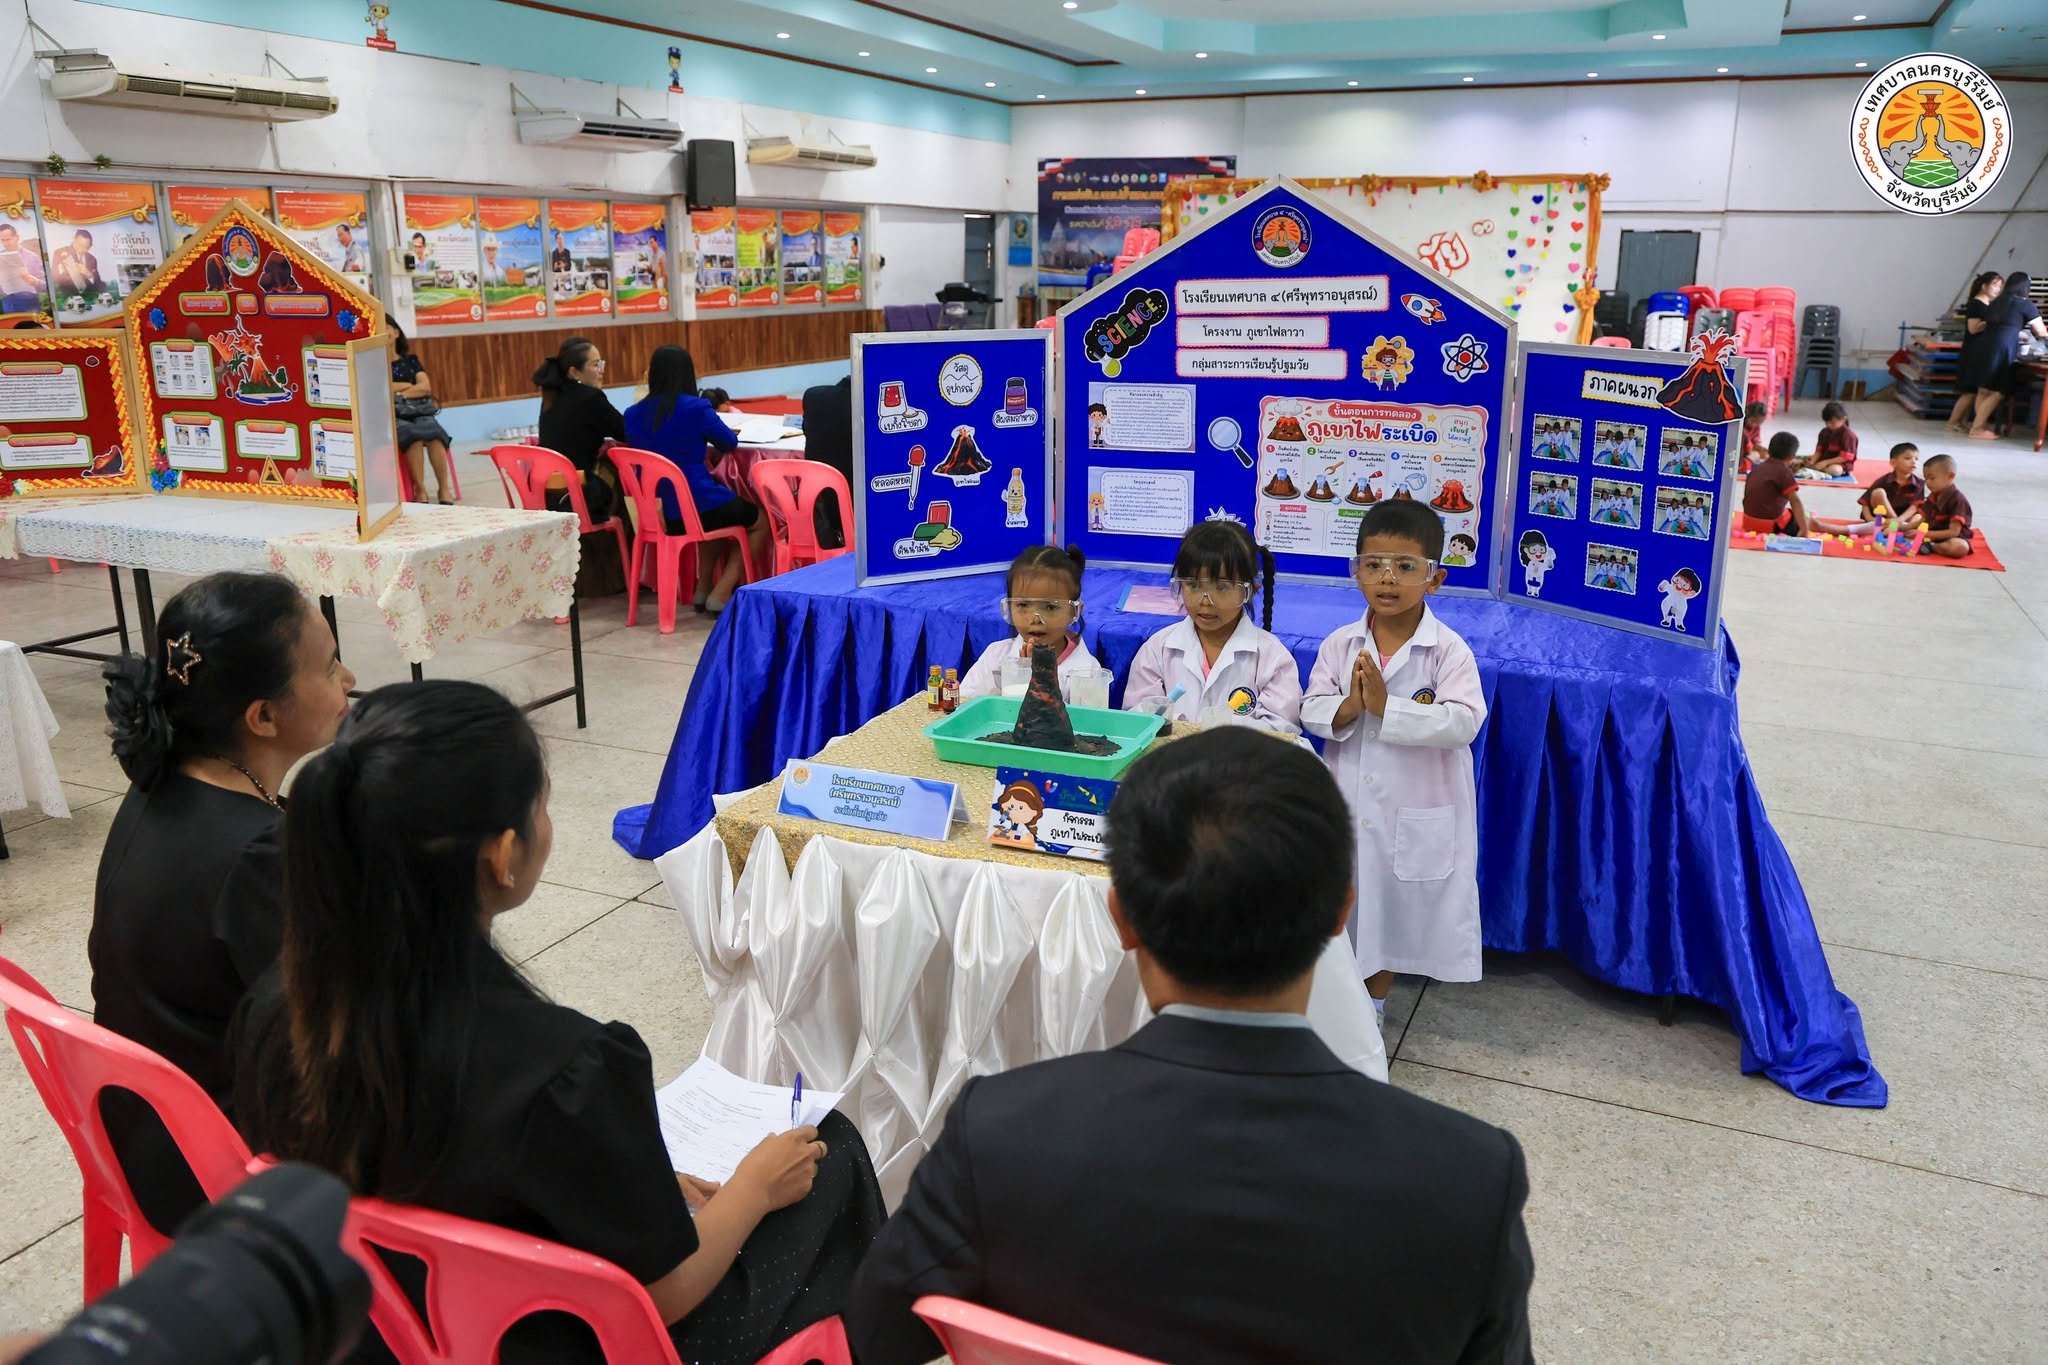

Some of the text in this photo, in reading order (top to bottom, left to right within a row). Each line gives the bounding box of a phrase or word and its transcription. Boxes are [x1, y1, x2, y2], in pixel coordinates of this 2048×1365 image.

[1182, 289, 1267, 304] โรงเรียนเทศบาล
[1098, 298, 1158, 353] SCIENCE
[1203, 325, 1305, 340] โครงงาน ภูเขาไฟลาวา
[953, 362, 969, 375] วัสดุ
[1192, 357, 1309, 374] กลุ่มสาระการเรียนรู้ปฐมวัย
[945, 382, 974, 396] อุปกรณ์
[1589, 376, 1657, 400] ภาคผนวก
[1333, 402, 1417, 419] ขั้นตอนการทดลอง
[874, 476, 911, 488] หลอดหยด
[832, 774, 896, 794] โรงเรียนเทศบาล
[829, 787, 901, 808] (ศรีพุทราอนุสรณ์)
[1063, 812, 1095, 826] กิจกรรม
[1051, 827, 1105, 844] ภูเขาไฟระเบิ
